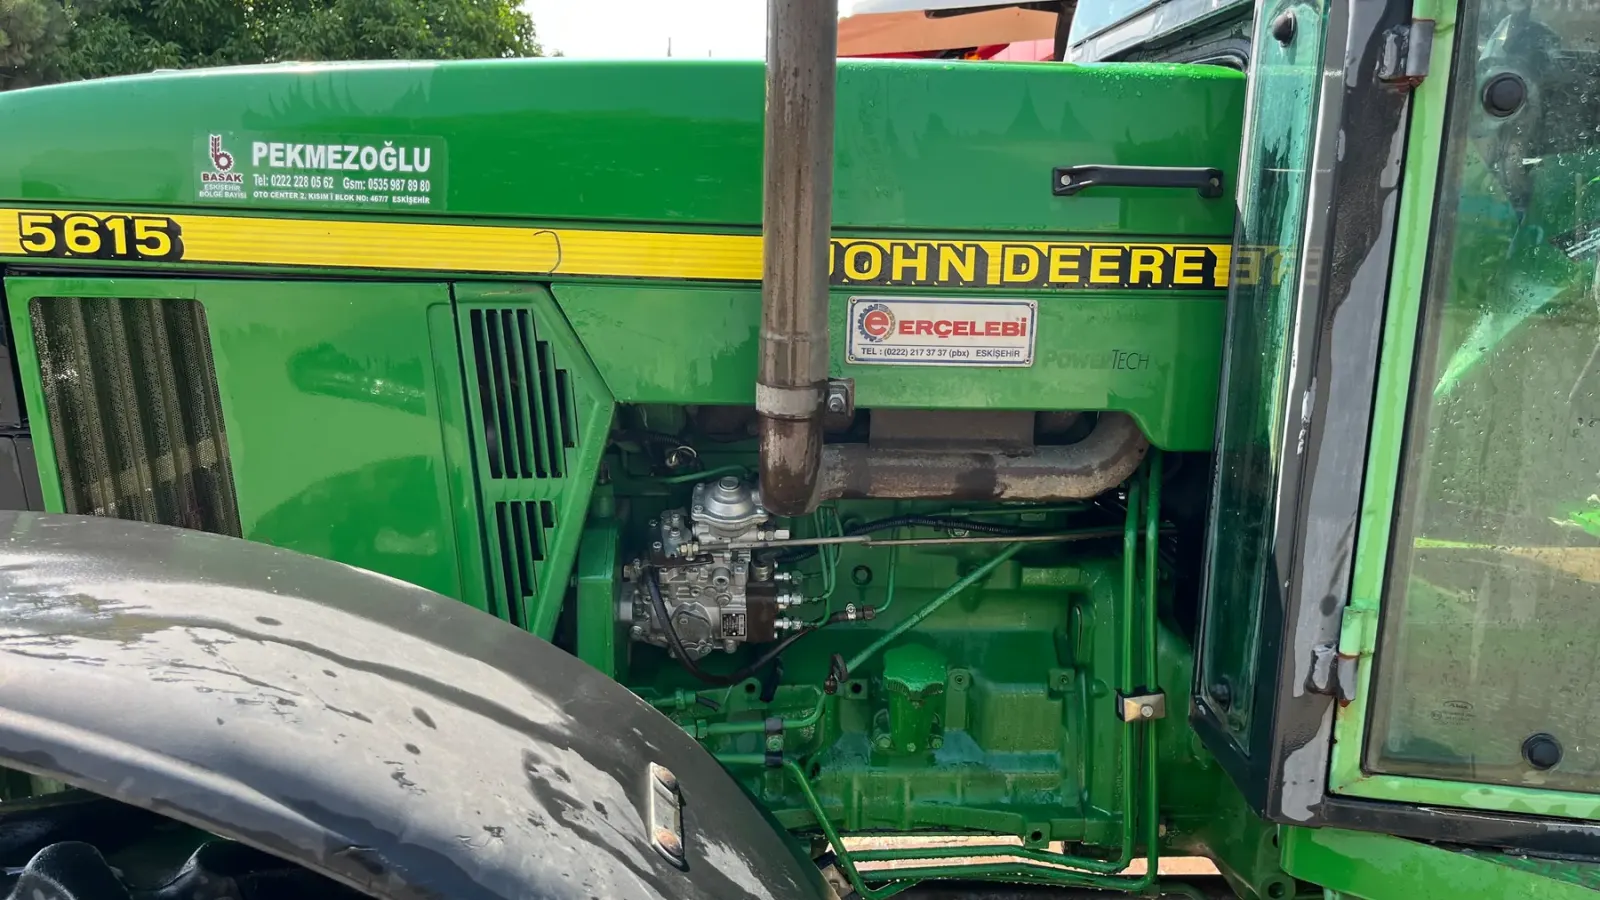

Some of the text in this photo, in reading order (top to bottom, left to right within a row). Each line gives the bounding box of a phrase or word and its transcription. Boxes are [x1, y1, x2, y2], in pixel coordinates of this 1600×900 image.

[252, 140, 431, 172] PEKMEZOĞLU
[252, 173, 431, 192] Tel: 0222 228 05 62 Gsm: 0535 987 89 80
[270, 191, 298, 199] CENTER
[335, 193, 355, 201] BLOK
[19, 213, 174, 258] 5615
[1002, 248, 1205, 286] DEERE
[898, 317, 1027, 339] ERÇELEBİ
[861, 347, 877, 355] TEL
[884, 347, 908, 356] (0222)
[910, 348, 925, 357] 217
[926, 349, 936, 357] 37
[937, 349, 948, 357] 37
[949, 349, 970, 358] (pbx)
[975, 348, 1021, 358] ESKİŞEHİR
